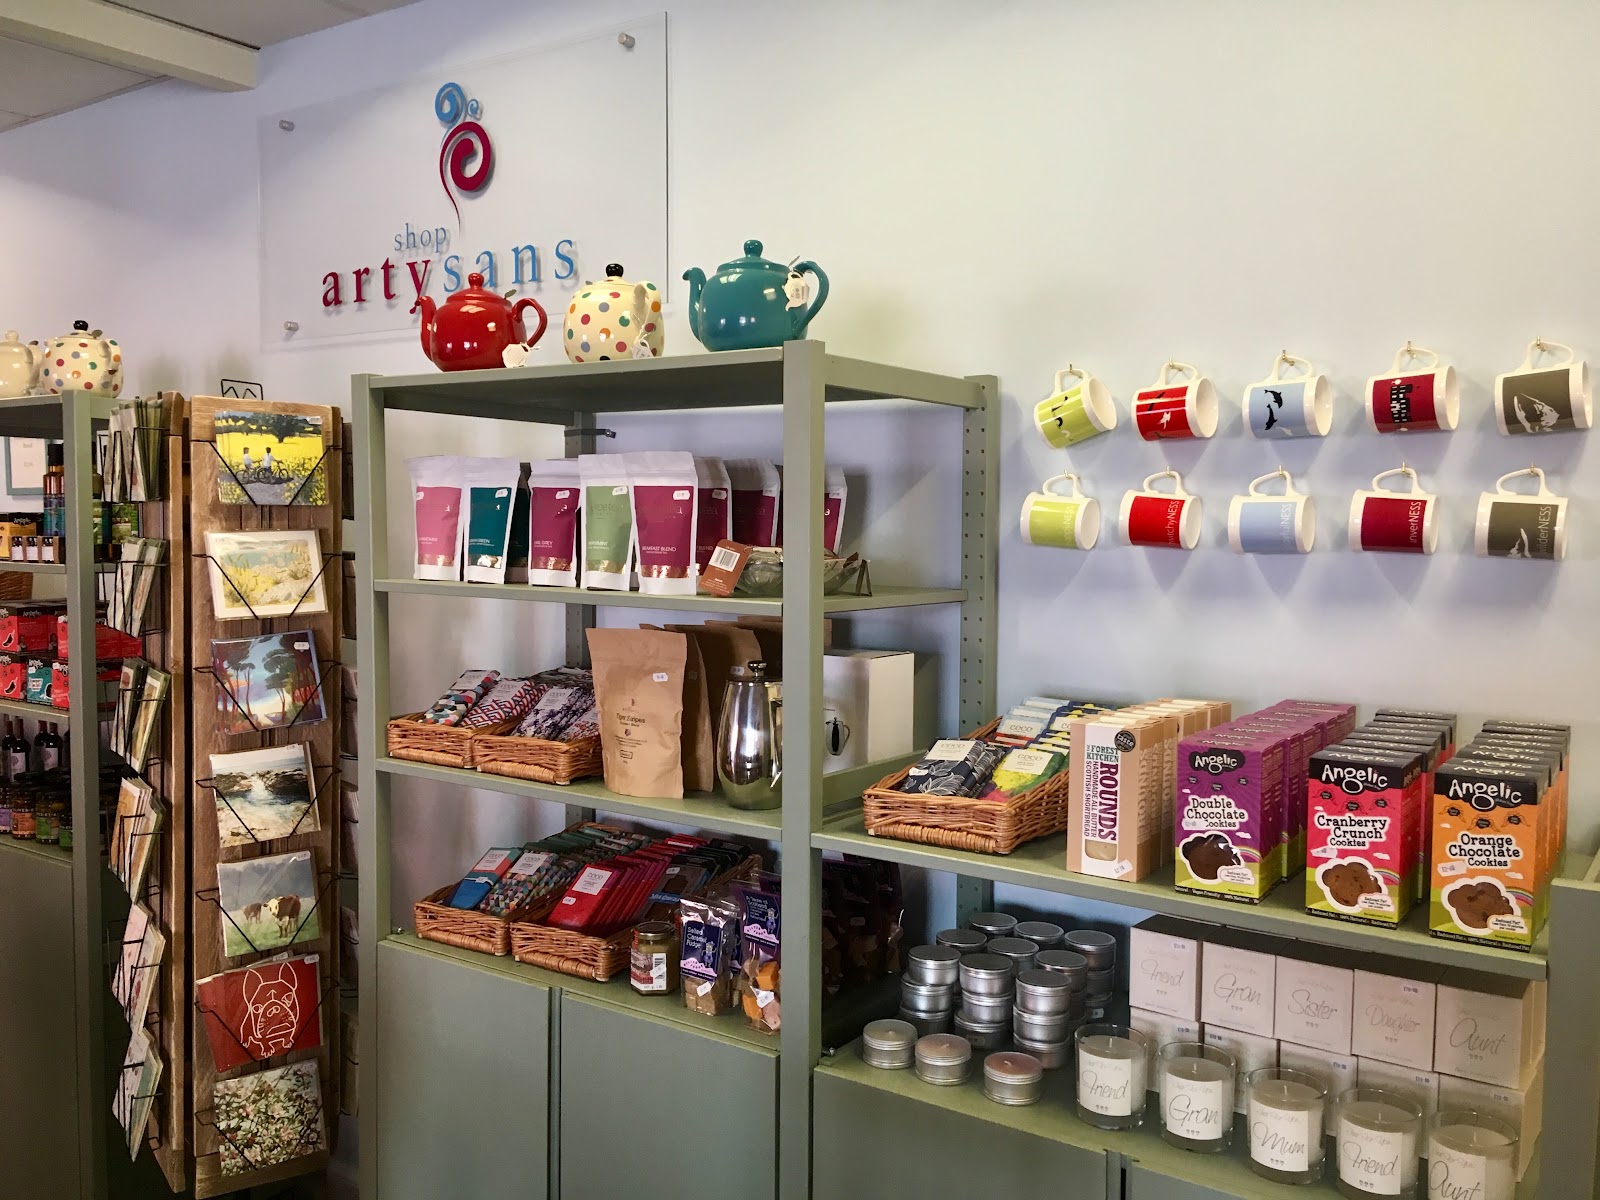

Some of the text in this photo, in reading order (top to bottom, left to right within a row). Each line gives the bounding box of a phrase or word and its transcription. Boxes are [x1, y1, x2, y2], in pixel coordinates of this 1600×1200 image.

[394, 223, 447, 253] shop
[322, 239, 575, 314] artysans
[1409, 501, 1421, 543] inverNESS
[1009, 724, 1033, 732] COCO
[1117, 733, 1134, 747] taste
[1017, 753, 1043, 761] COCO
[1086, 751, 1119, 763] KITCHEN
[1091, 745, 1119, 756] FOREST
[1194, 753, 1238, 774] Angelic
[1091, 760, 1099, 800] HANDMADE
[1321, 764, 1388, 794] Angelic
[1098, 761, 1119, 842] ROUNDS
[1191, 797, 1233, 809] Double
[1449, 779, 1522, 810] Angelic
[1090, 812, 1098, 838] BUTTER
[1186, 808, 1246, 820] Chocolate
[1317, 814, 1387, 830] Cranberry
[1329, 838, 1366, 847] Cookies
[1333, 826, 1383, 839] Crunch
[1460, 833, 1513, 848] Orange
[1448, 844, 1521, 858] Chocolate
[1467, 858, 1509, 867] Cookies
[686, 939, 701, 949] Fudge
[687, 926, 704, 936] Salted
[687, 933, 707, 943] Caramel
[1140, 959, 1185, 987] Friend
[1213, 973, 1263, 1006] Gran
[1287, 988, 1338, 1020] Sister
[1365, 1004, 1421, 1036] Daughter
[1449, 1017, 1506, 1055] Aunt
[1081, 1070, 1129, 1100] Friend
[1169, 1094, 1220, 1127] Gran
[1252, 1121, 1305, 1155] Mum
[1342, 1140, 1399, 1177] Friend
[1430, 1160, 1481, 1200] Aunt
